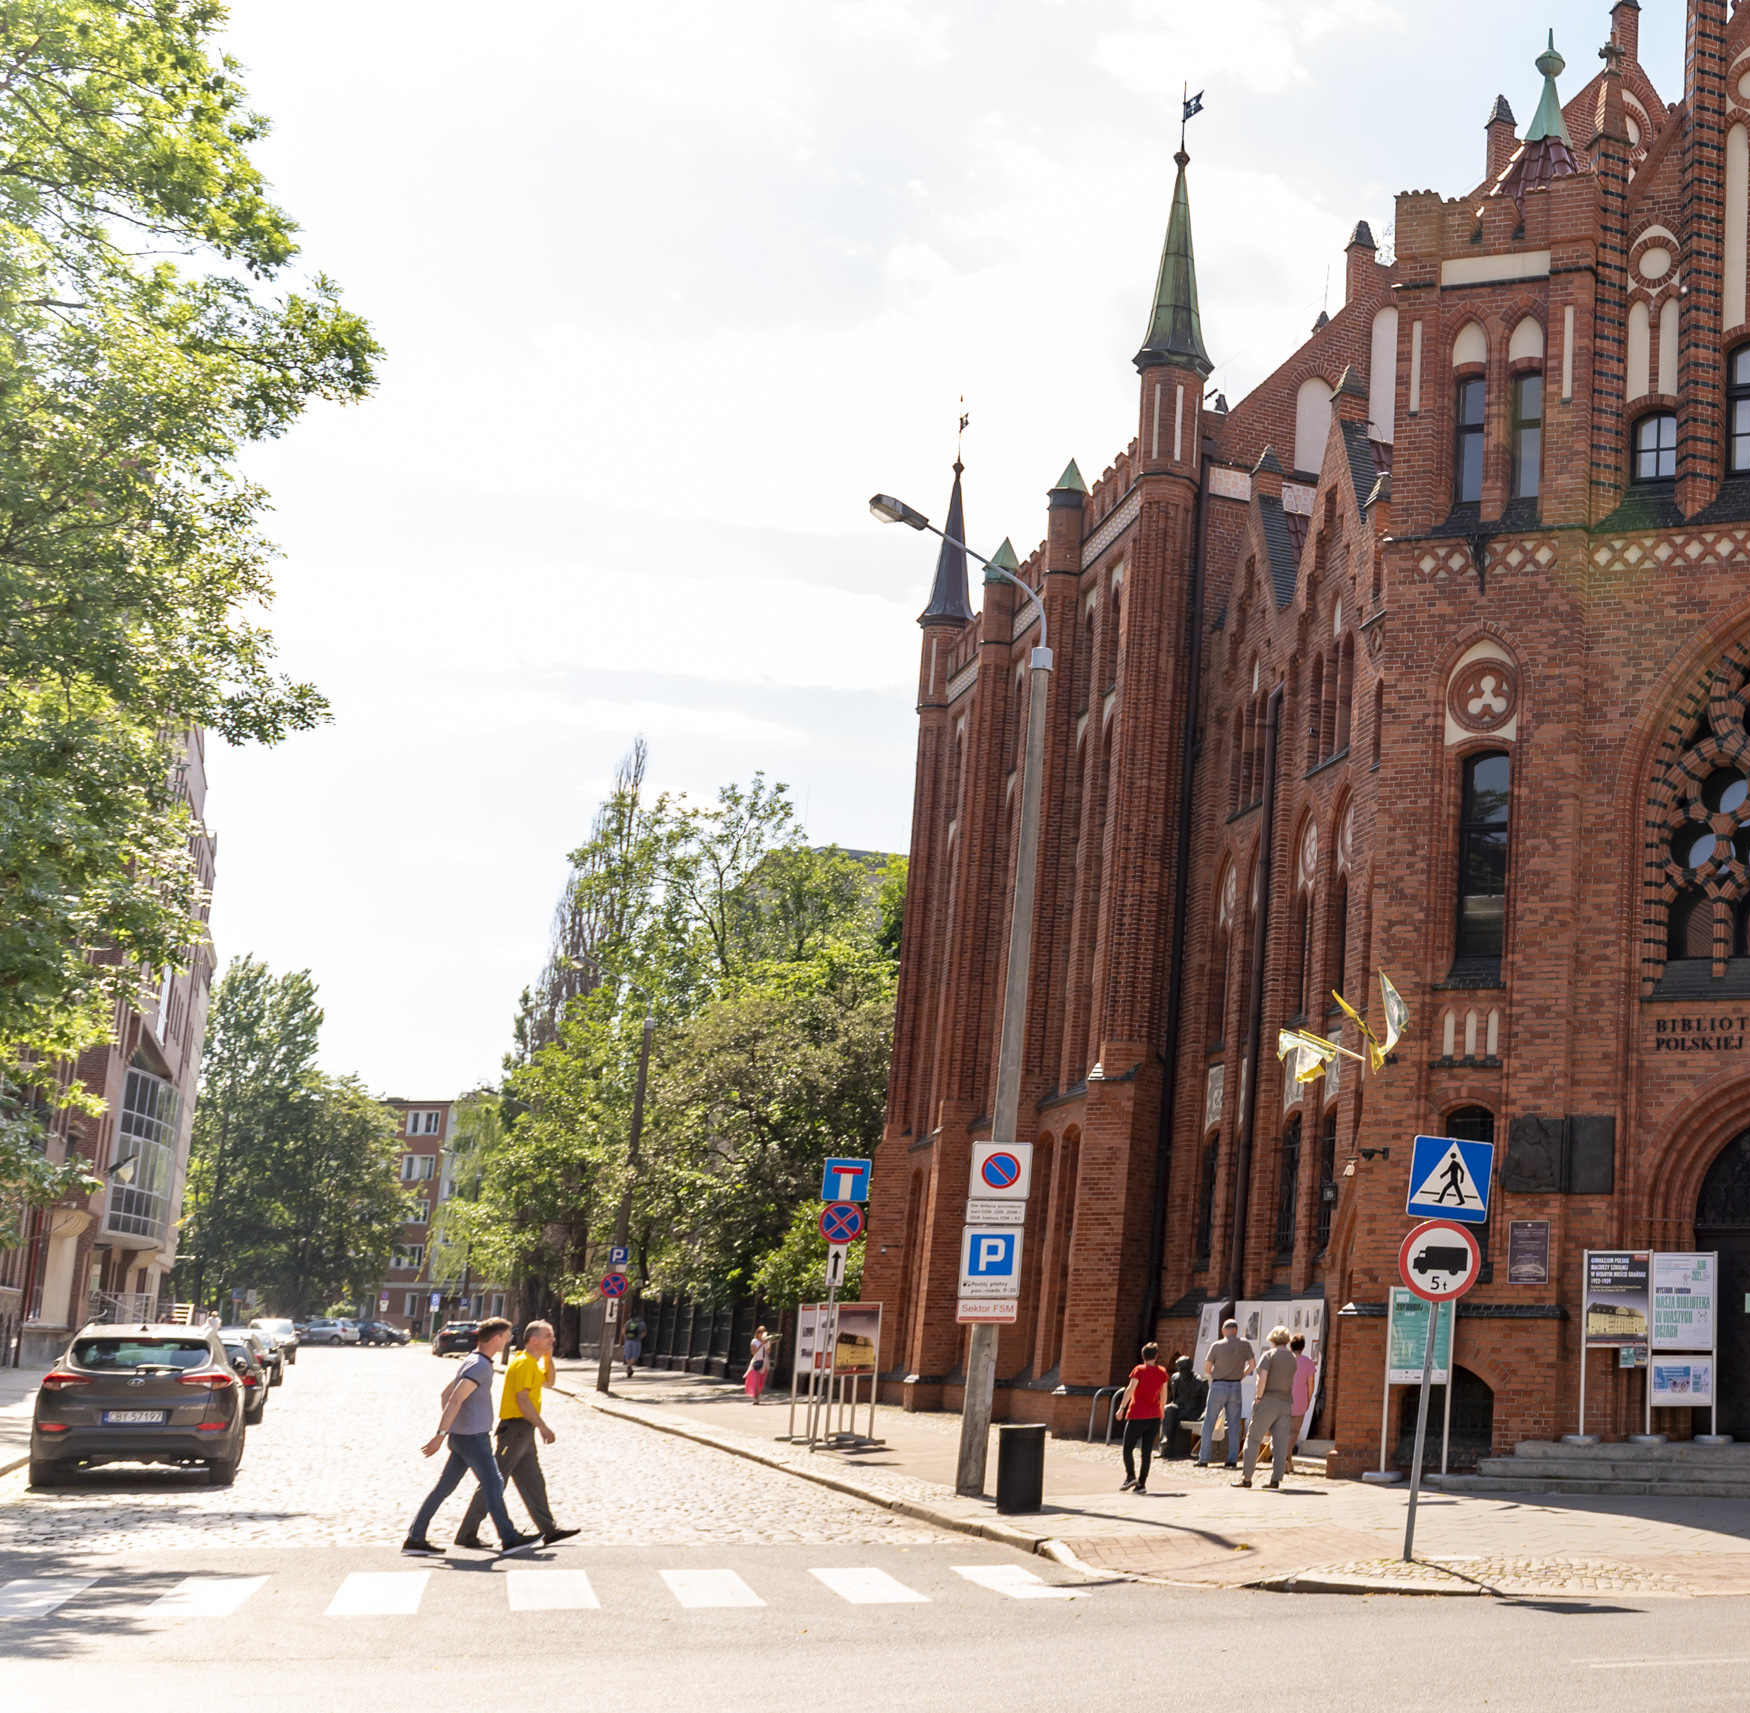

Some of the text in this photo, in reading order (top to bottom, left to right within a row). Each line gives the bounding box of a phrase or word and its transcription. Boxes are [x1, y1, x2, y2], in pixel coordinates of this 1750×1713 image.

[1655, 1034, 1744, 1051] POLSKIEJ
[978, 1238, 1006, 1271] P
[1430, 1276, 1448, 1291] 5 t
[962, 1304, 1015, 1313] Sektor FSM
[1655, 1296, 1711, 1310] NASZA BIBLIOTEKA
[1655, 1310, 1693, 1324] W WASZYCH
[1654, 1325, 1678, 1338] OCZACH
[109, 1411, 162, 1422] CBY 57197
